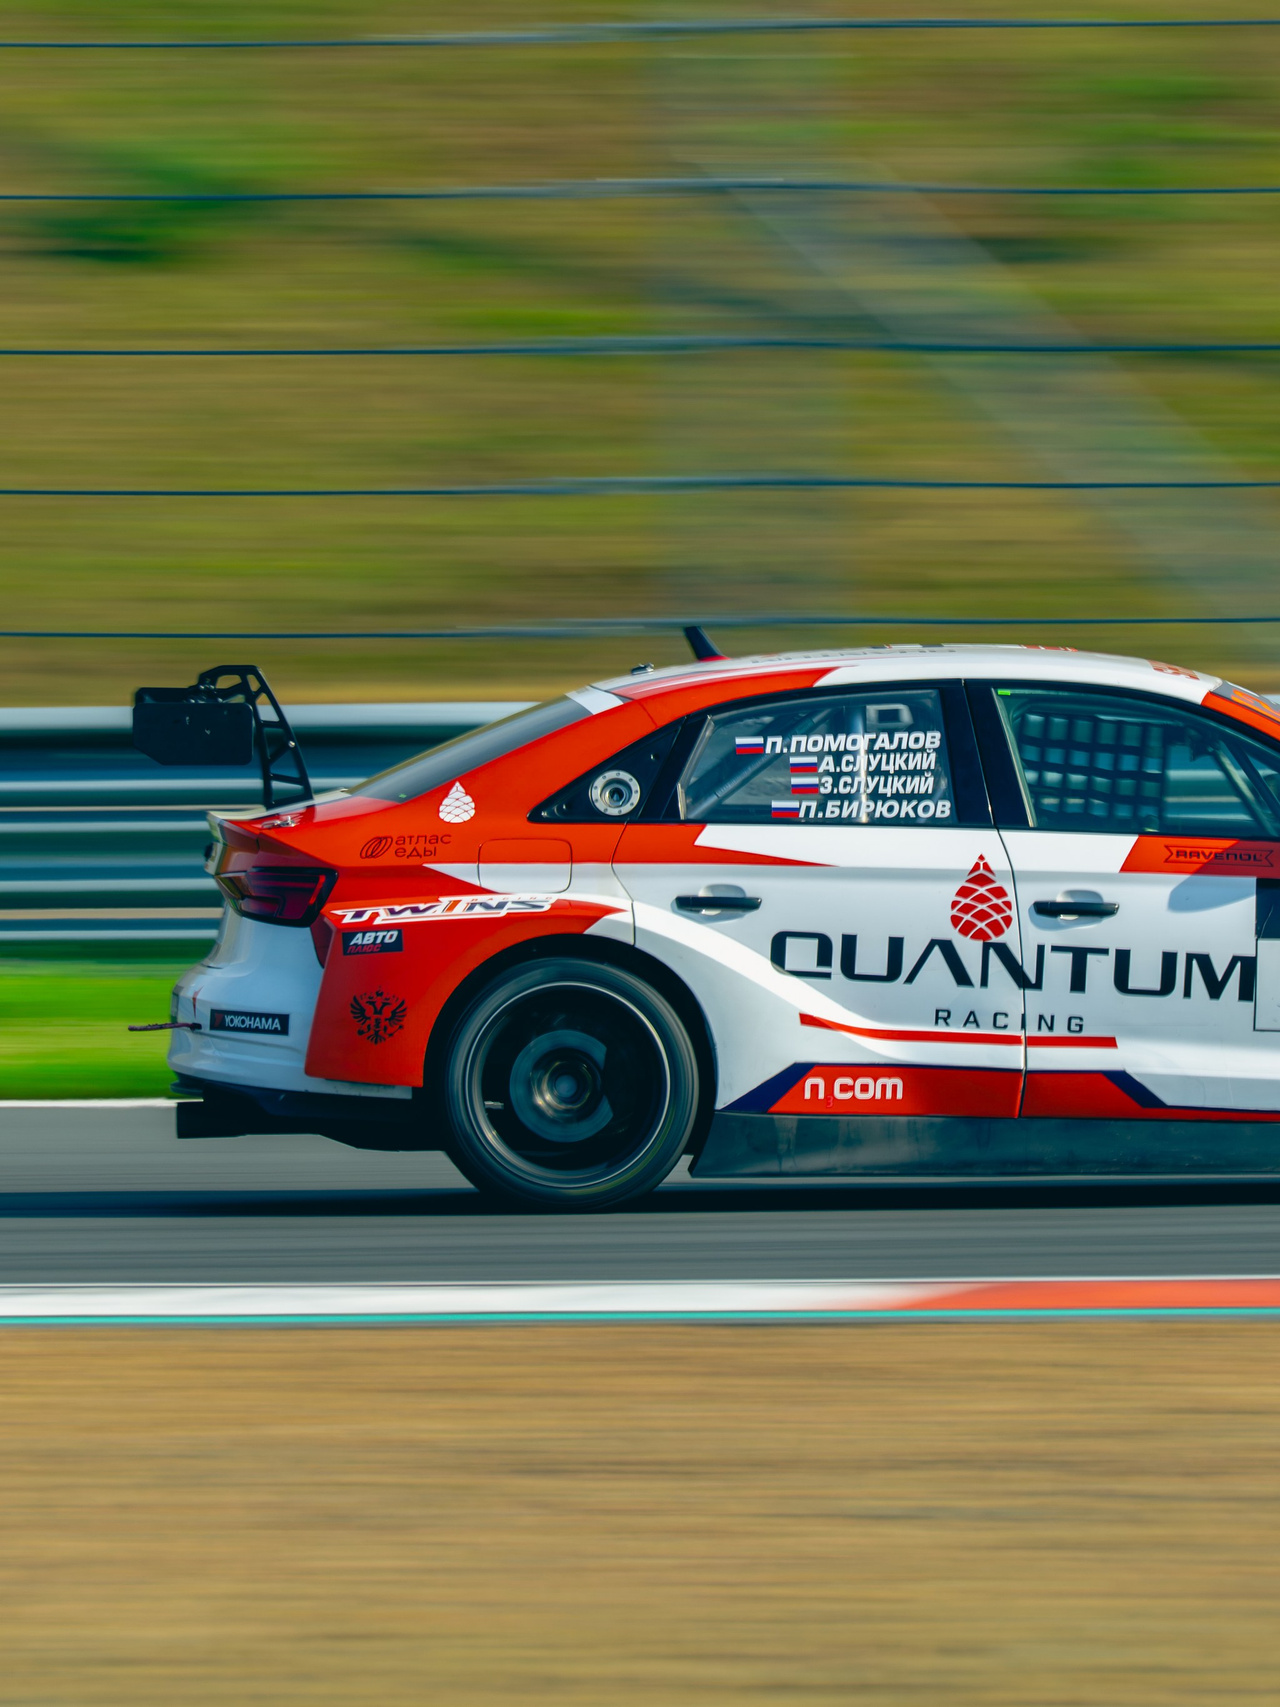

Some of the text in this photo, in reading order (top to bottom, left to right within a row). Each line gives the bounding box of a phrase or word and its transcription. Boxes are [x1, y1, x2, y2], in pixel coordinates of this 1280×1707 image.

[765, 731, 942, 754] П.ПОМОГАЛОВ
[817, 748, 937, 774] А.СЛУЦКИЙ
[819, 772, 935, 797] З.СЛУЦКИЙ
[799, 800, 952, 819] П.БИРЮКОВ
[395, 834, 452, 846] атлас
[394, 846, 437, 859] еды
[333, 896, 550, 921] TWINS
[349, 930, 399, 945] АВТО
[347, 944, 382, 953] ПЛЮС
[770, 930, 1257, 1002] QUANTUM
[225, 1014, 281, 1031] YOKOHAMA
[934, 1008, 1085, 1034] RACING
